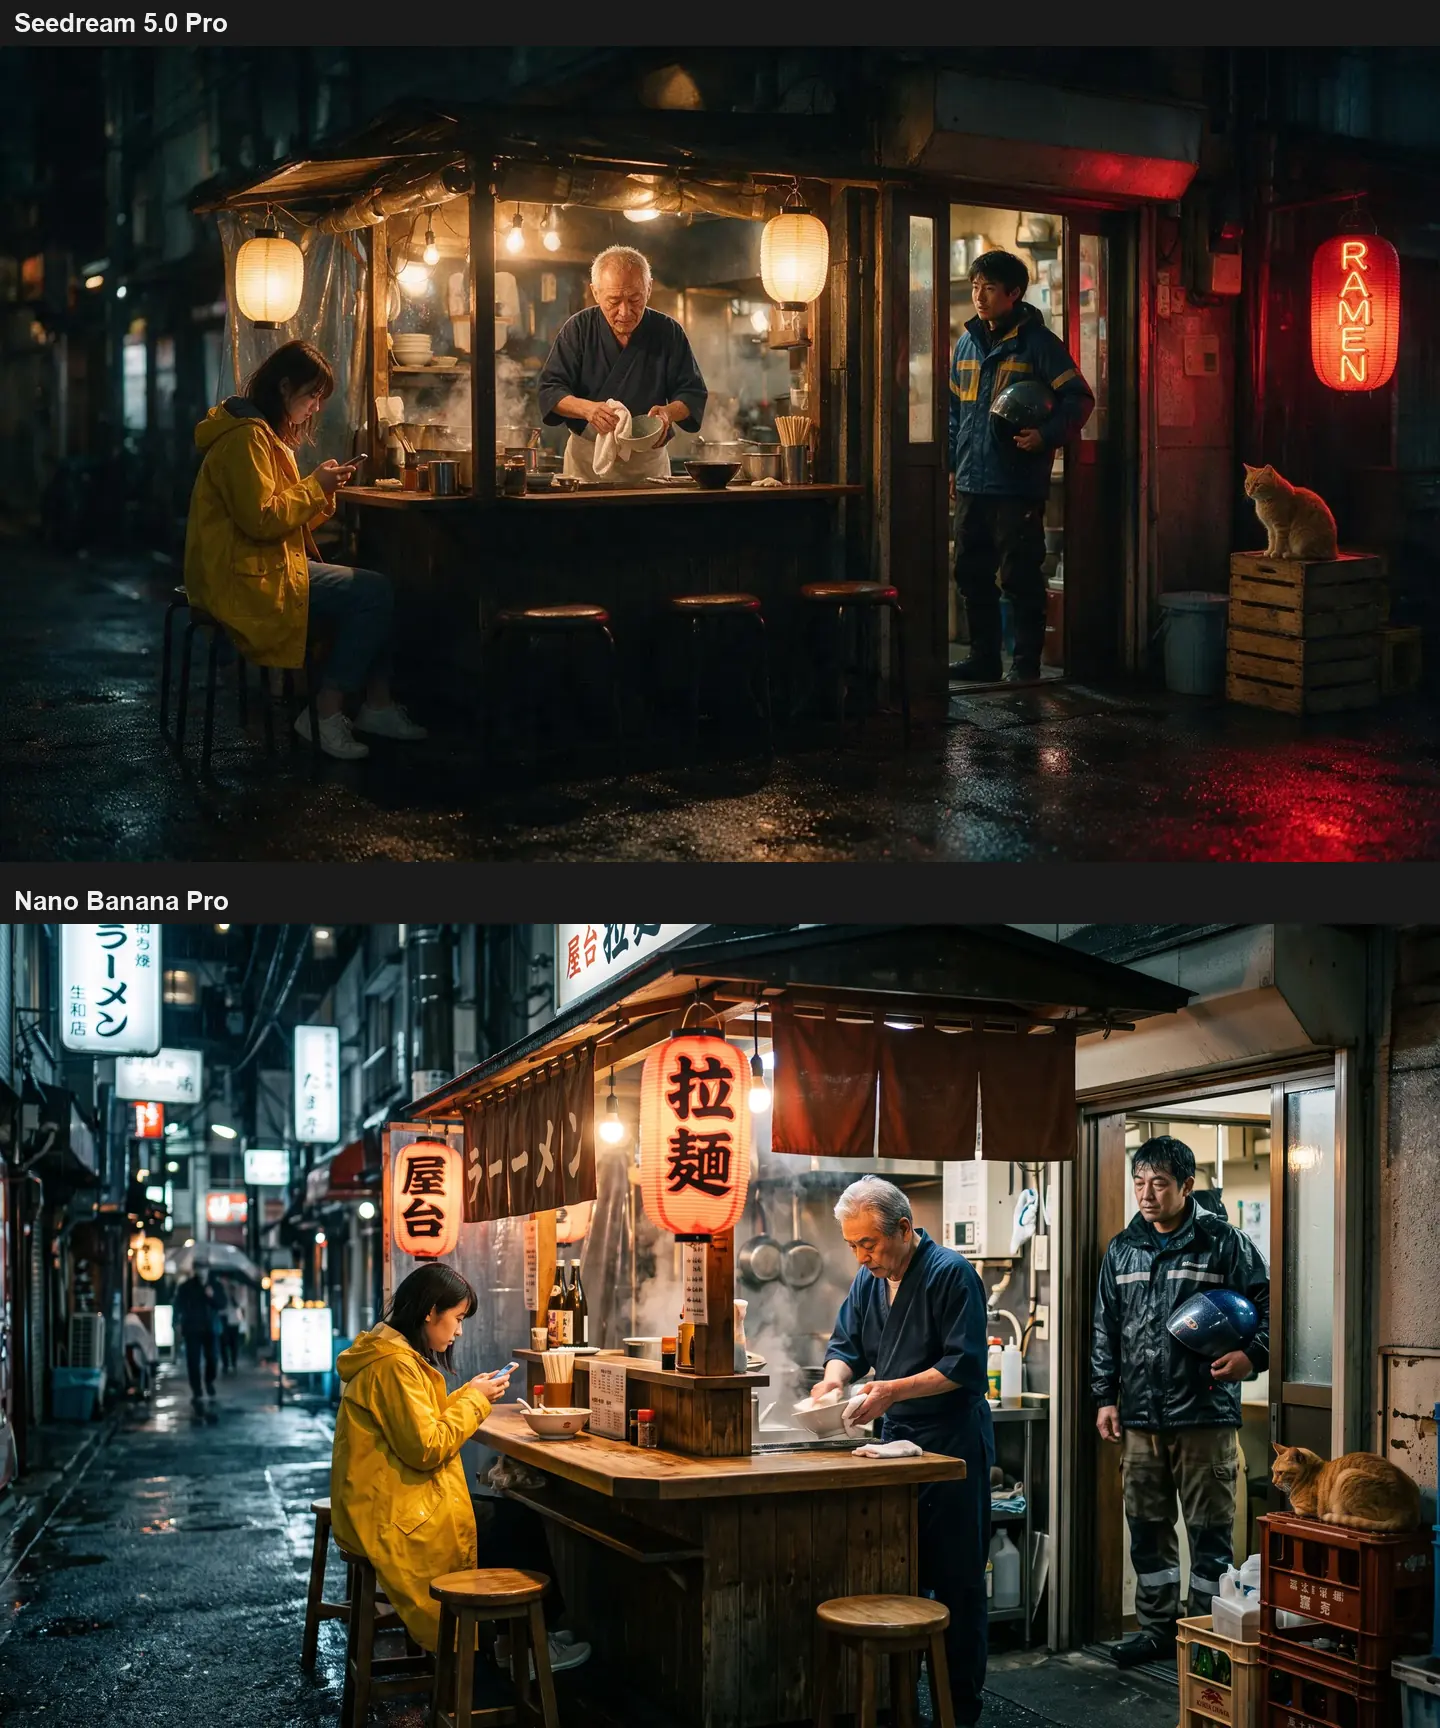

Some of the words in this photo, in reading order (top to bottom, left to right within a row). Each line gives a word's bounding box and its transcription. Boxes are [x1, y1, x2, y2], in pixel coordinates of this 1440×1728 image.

[1338, 242, 1371, 382] RAMEN
[70, 984, 87, 1036] 生和店
[96, 924, 128, 1037] ラーメン
[401, 1155, 447, 1238] 屋台
